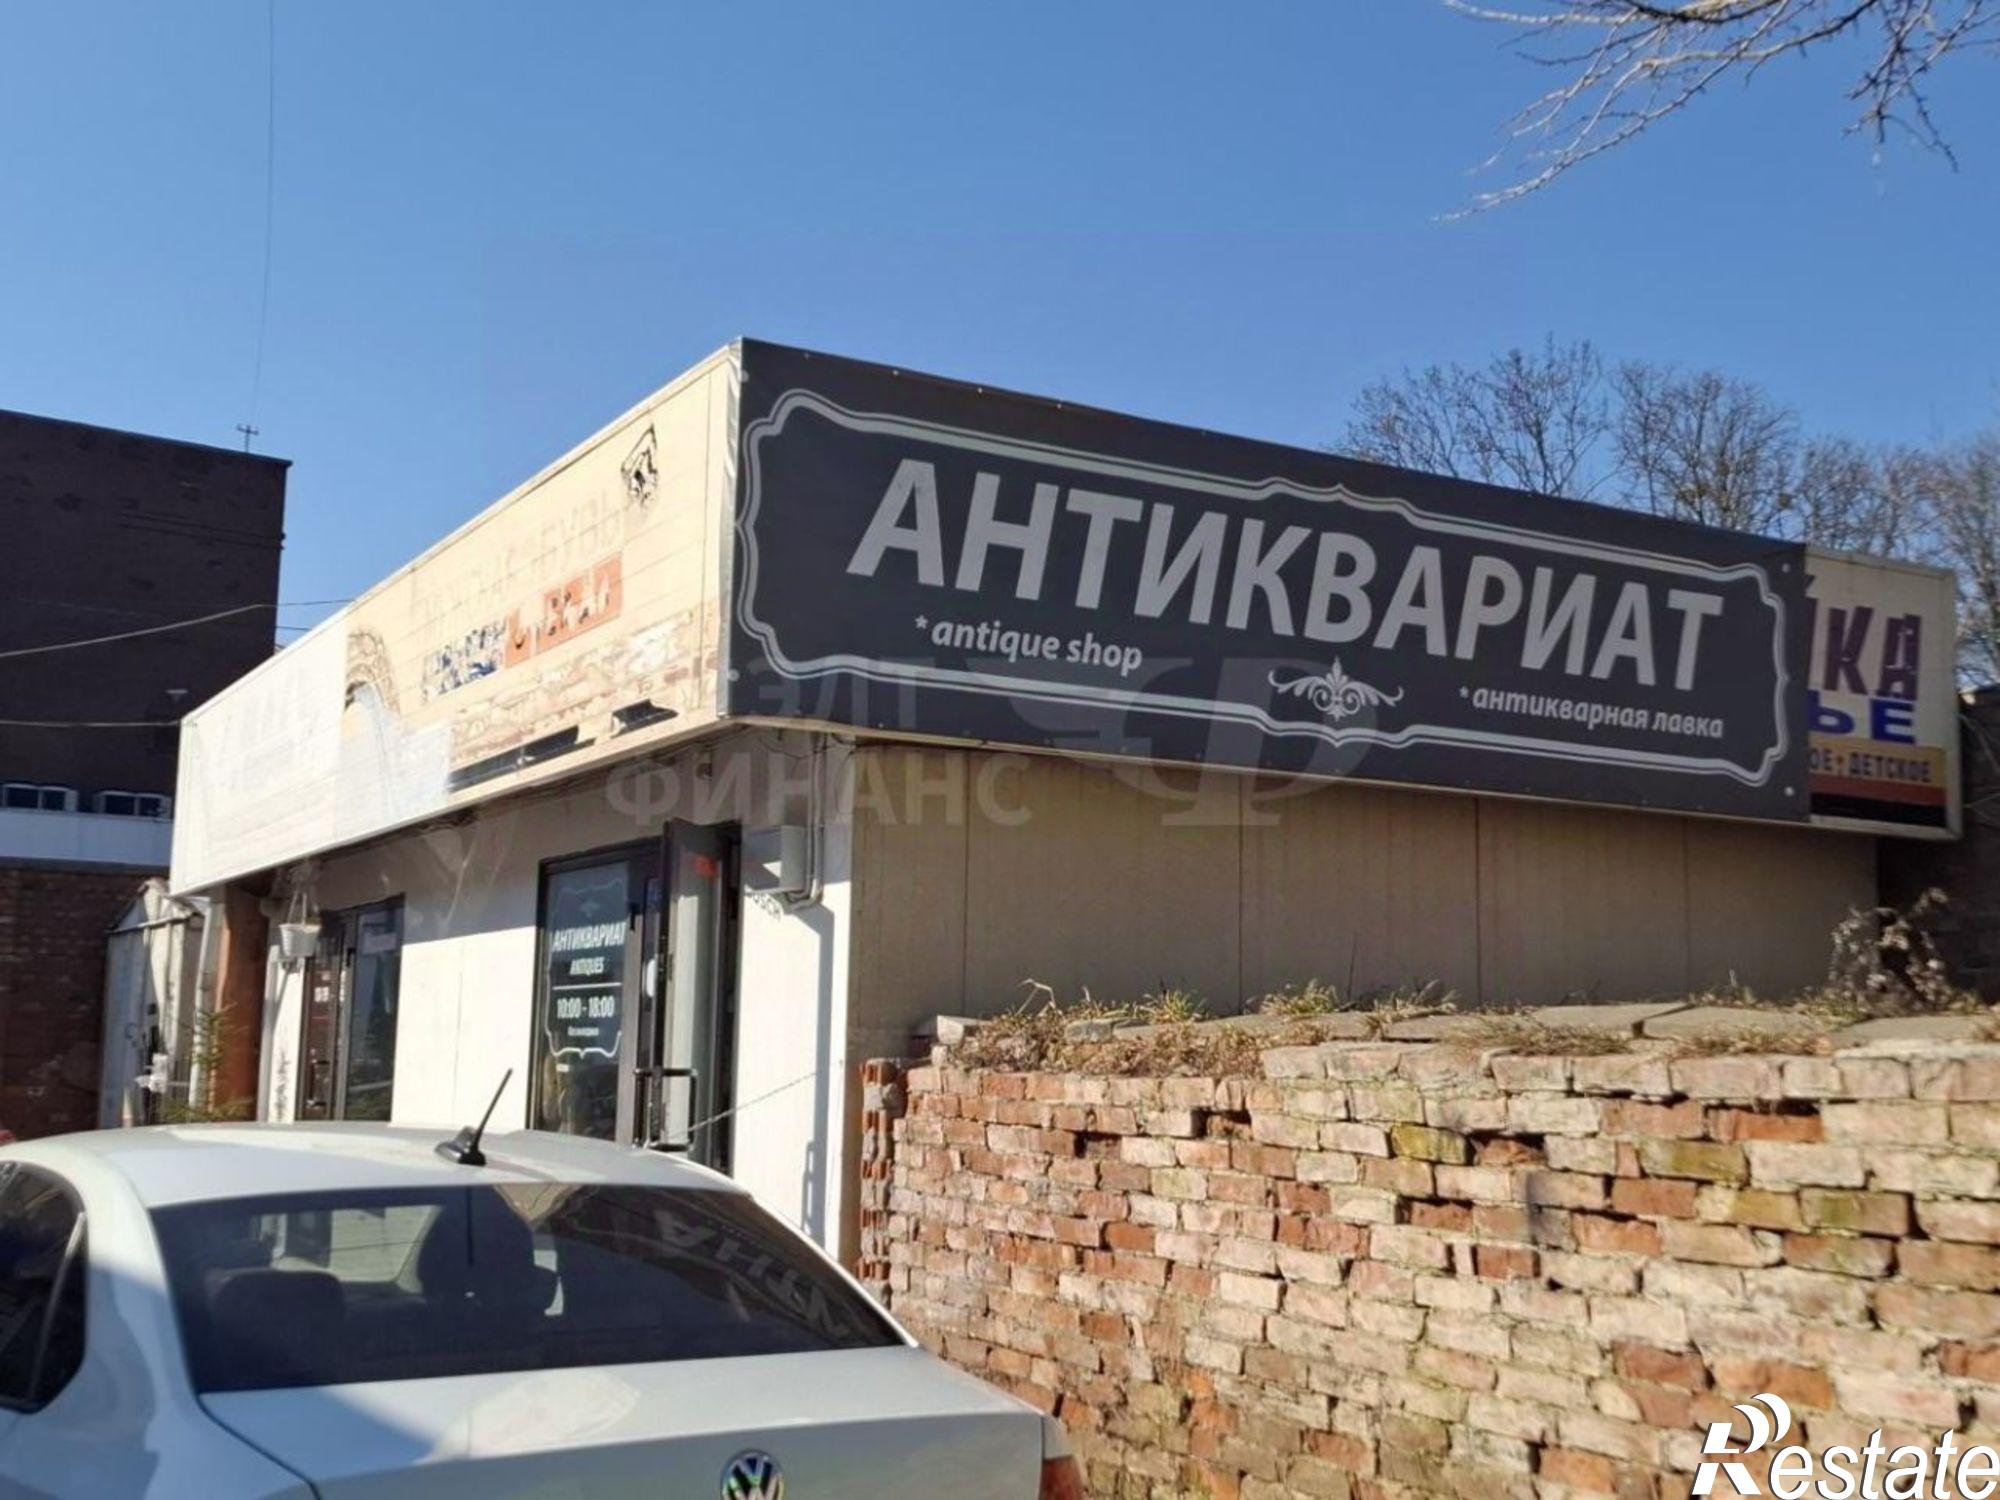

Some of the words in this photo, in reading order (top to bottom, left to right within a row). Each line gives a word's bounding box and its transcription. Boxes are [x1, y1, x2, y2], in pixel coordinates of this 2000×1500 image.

[846, 457, 1724, 692] АНТИКВАРИАТ
[1065, 631, 1143, 677] shop
[1651, 711, 1724, 739] лавка
[552, 921, 627, 952] АНТИКВАРИАТ
